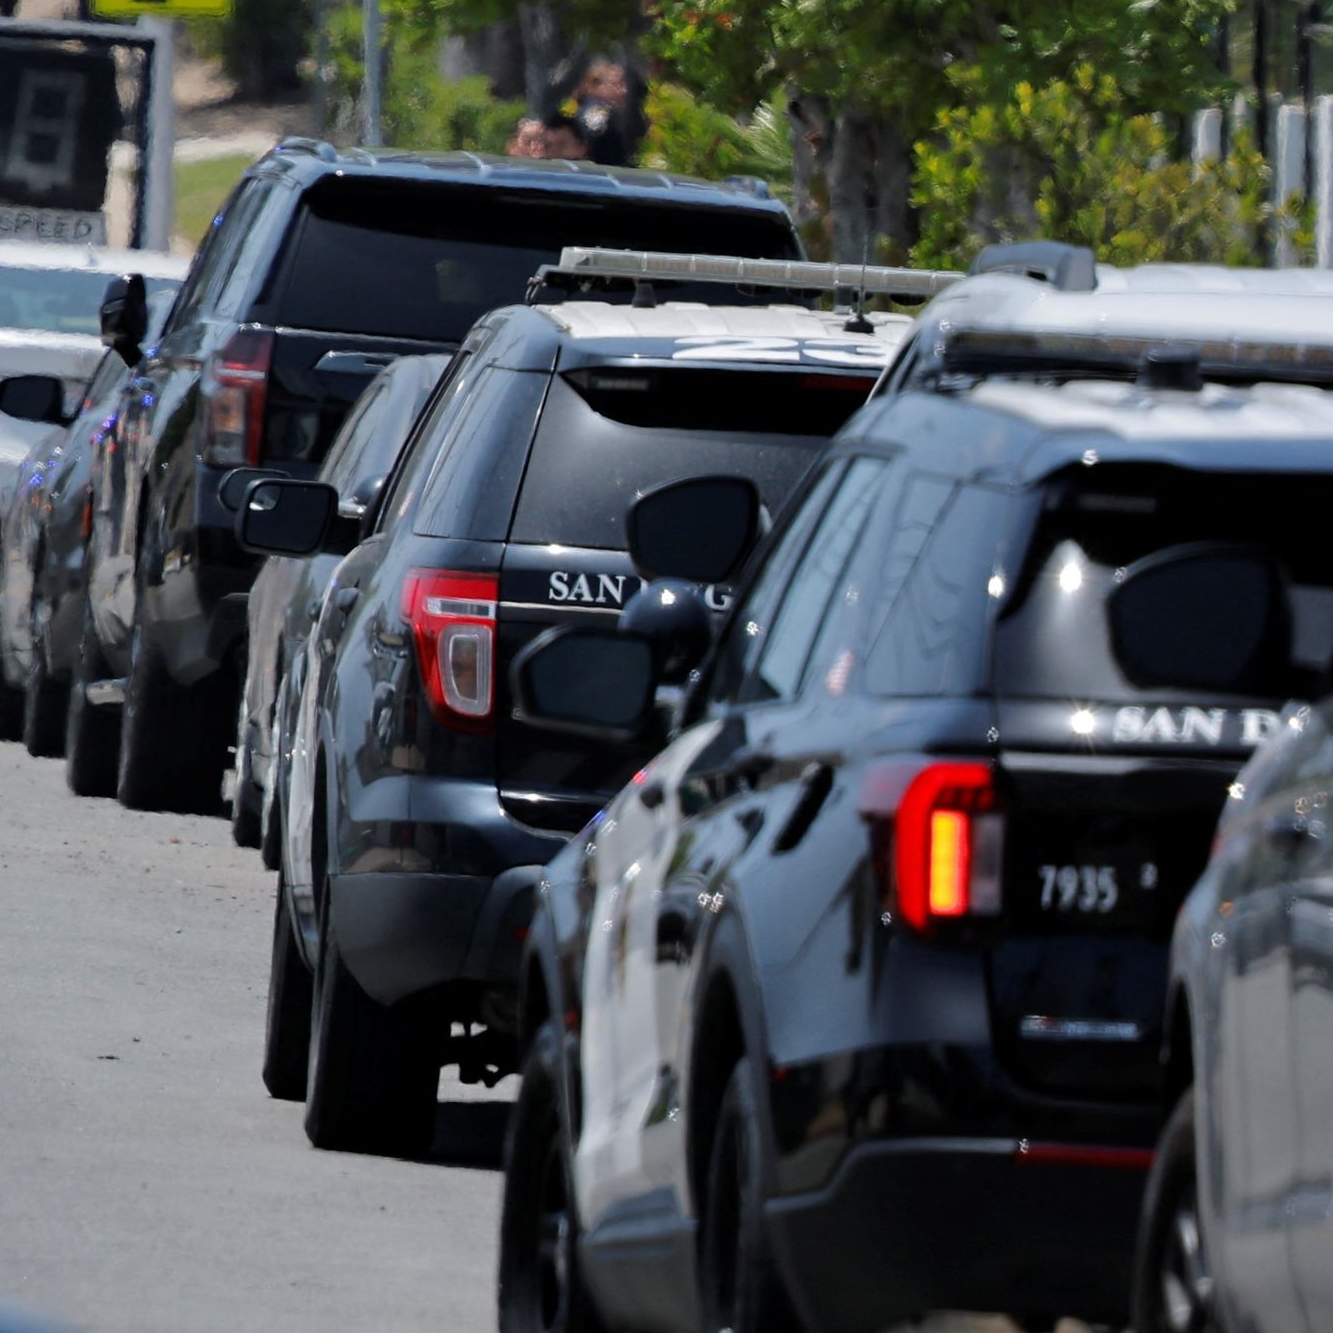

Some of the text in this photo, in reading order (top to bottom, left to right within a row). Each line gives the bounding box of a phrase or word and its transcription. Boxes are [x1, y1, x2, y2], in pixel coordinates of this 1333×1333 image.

[548, 571, 627, 605] SAN
[1113, 706, 1228, 746] SAN
[1038, 865, 1118, 912] 7935
